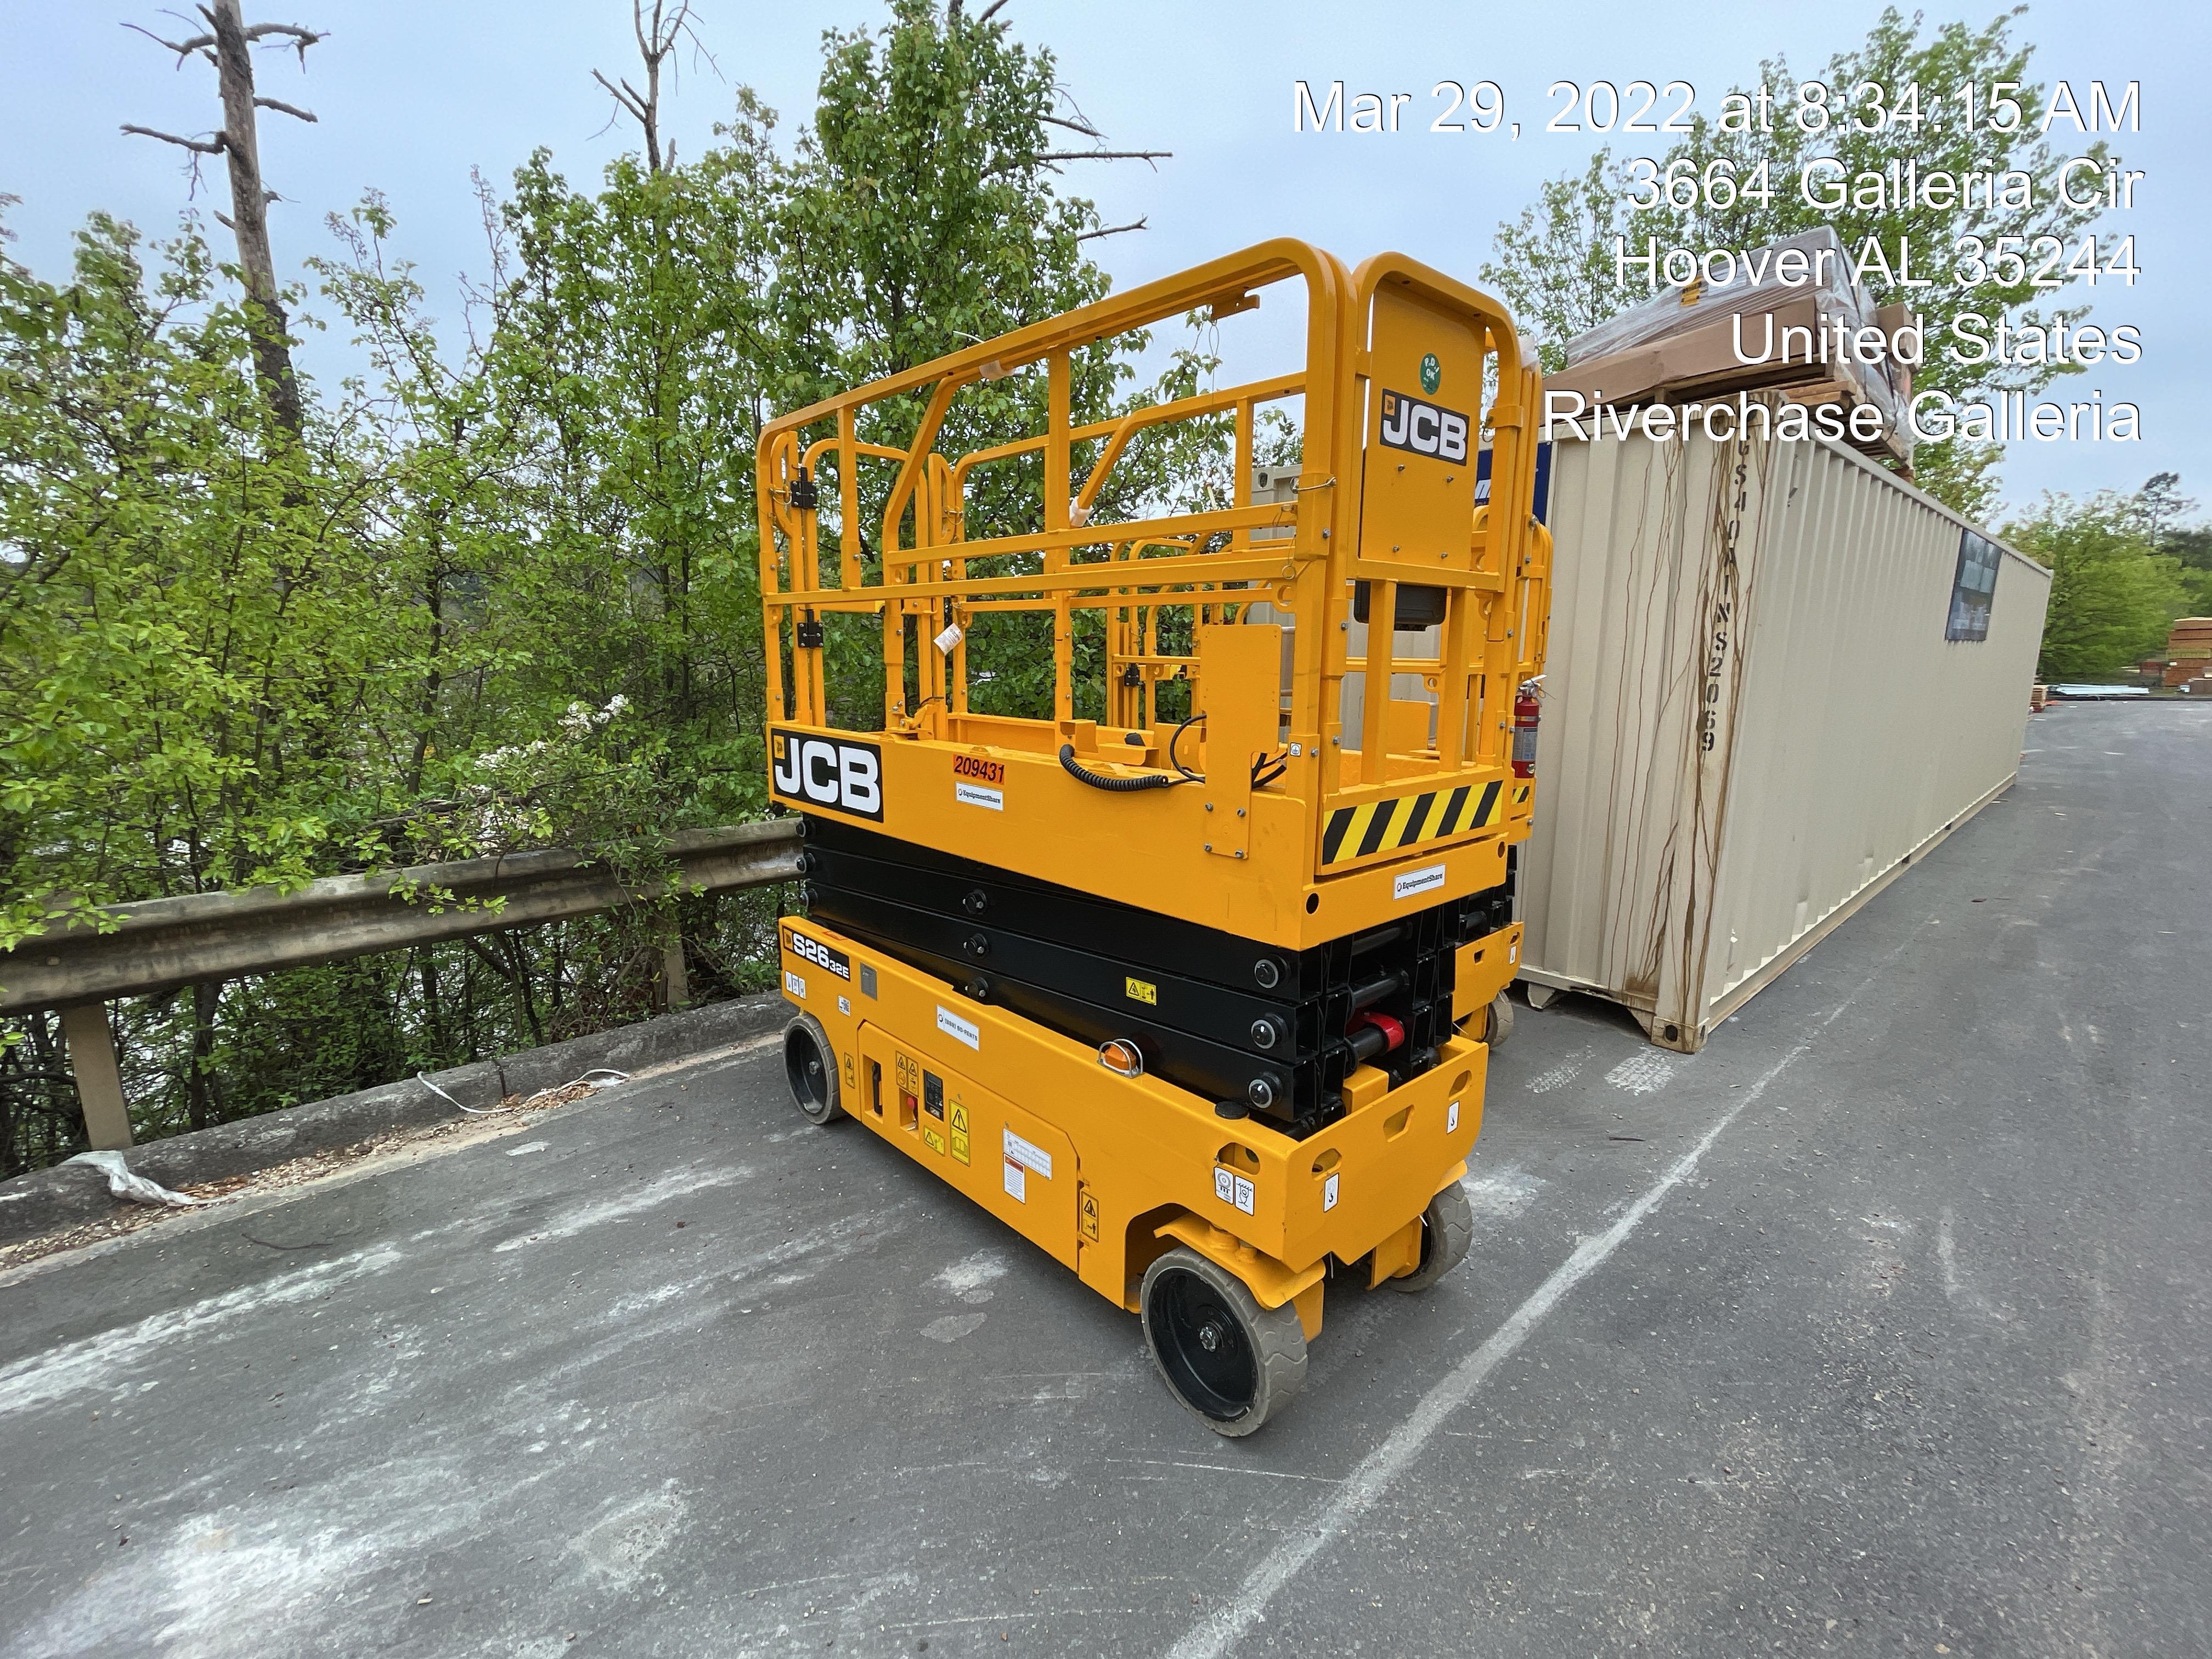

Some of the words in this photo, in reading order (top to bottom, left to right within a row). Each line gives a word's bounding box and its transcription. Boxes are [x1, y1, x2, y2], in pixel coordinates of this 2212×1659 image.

[1383, 399, 1466, 460] JCB
[775, 737, 880, 813] JCB
[954, 755, 1005, 783] 209431
[962, 789, 1001, 804] EquipmentShare
[1402, 873, 1443, 889] EquipmentShare
